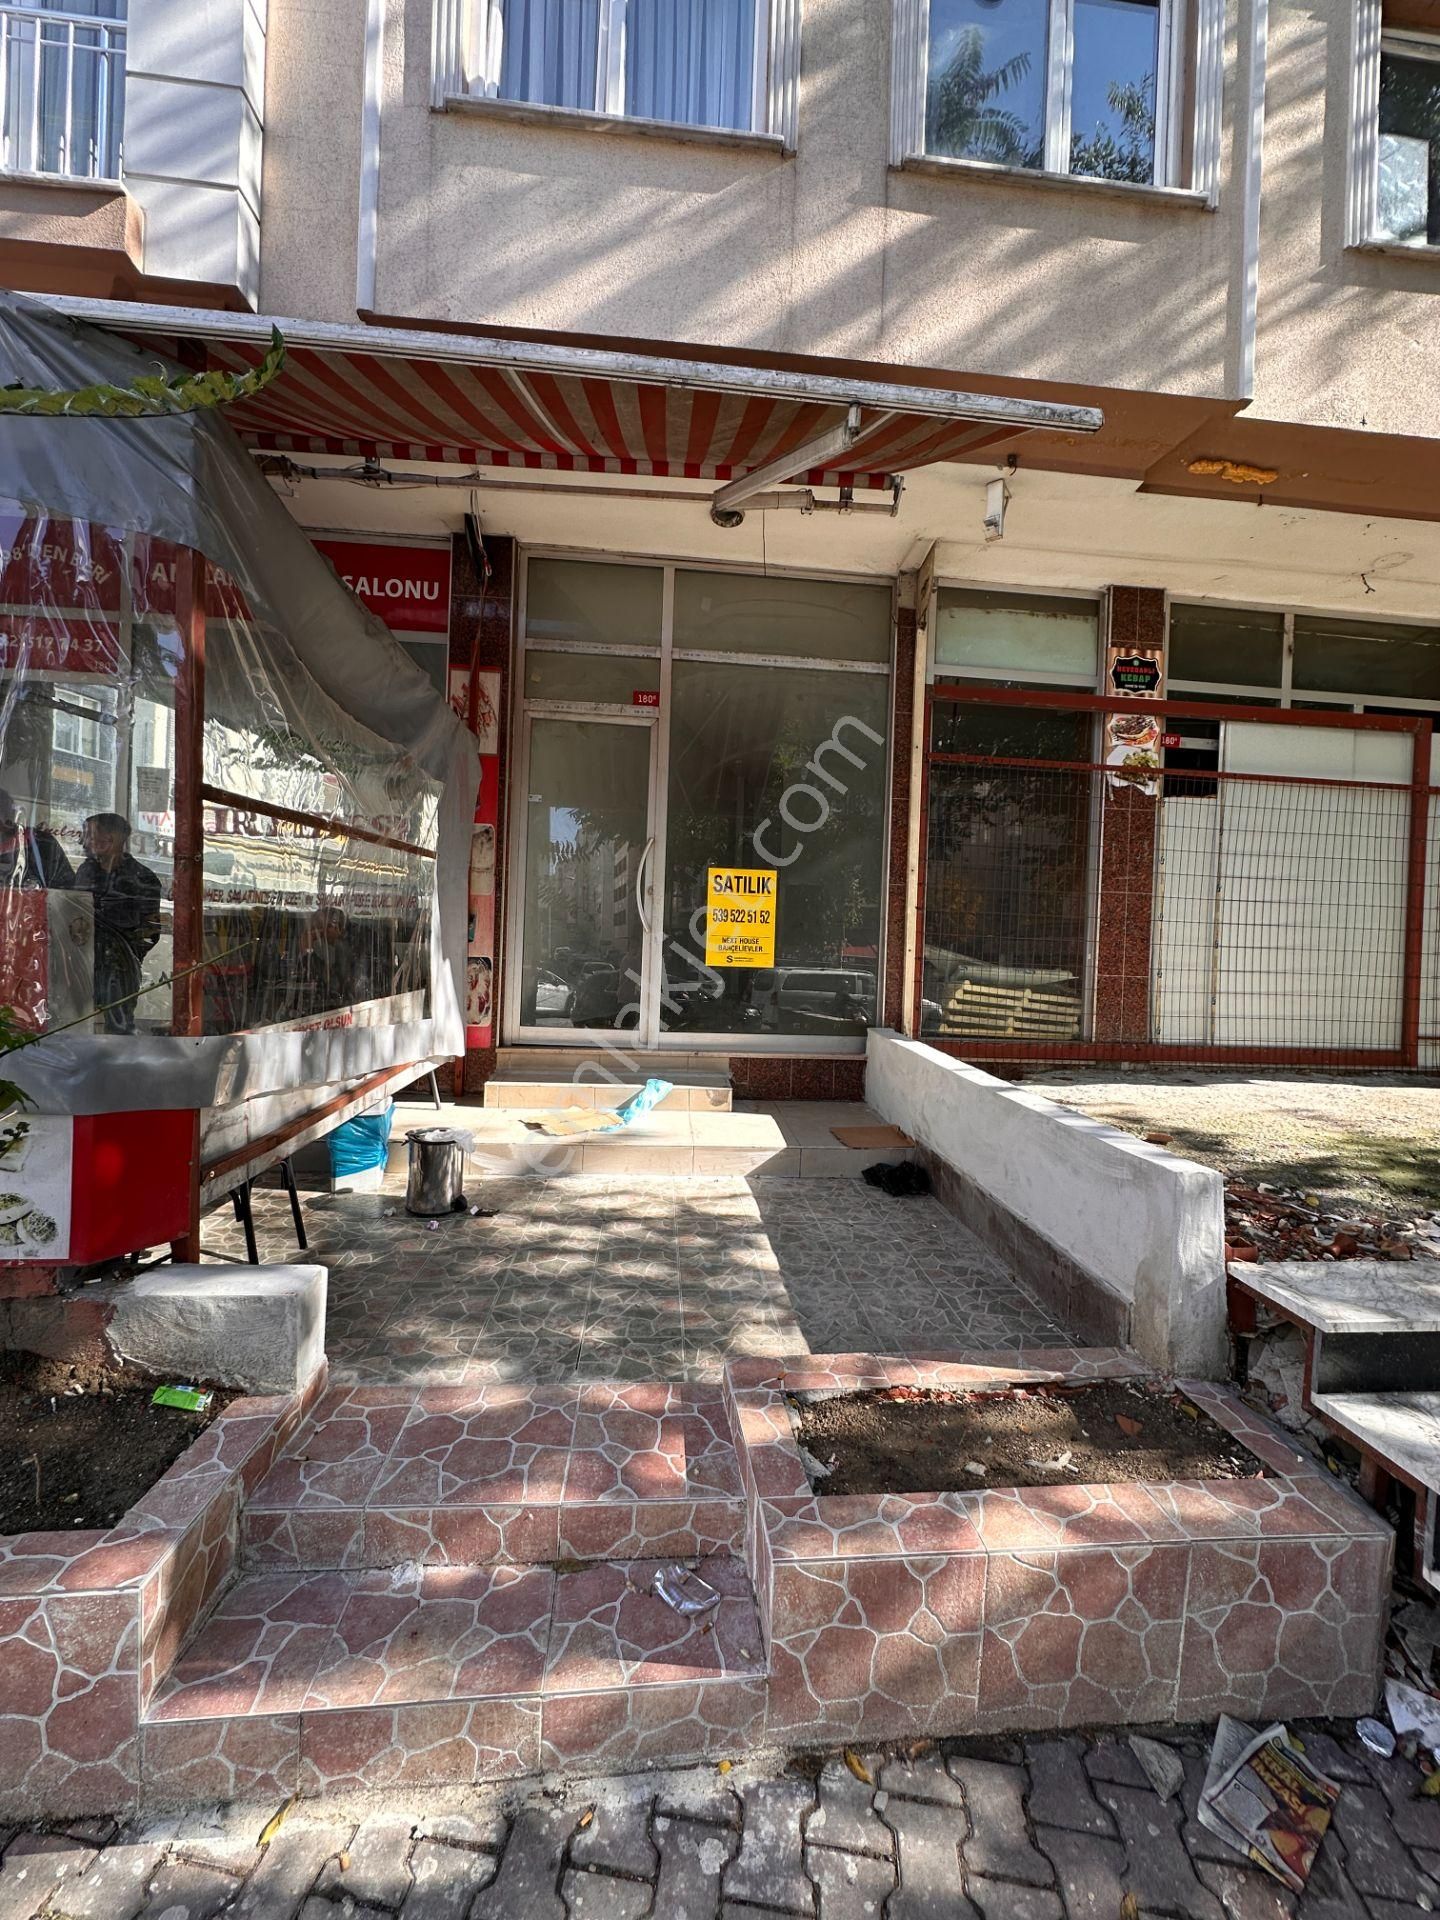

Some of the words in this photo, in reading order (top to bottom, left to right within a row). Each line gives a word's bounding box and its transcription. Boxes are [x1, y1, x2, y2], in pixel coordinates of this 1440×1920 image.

[341, 575, 439, 600] SALONU
[713, 874, 772, 894] SATILIK
[713, 909, 729, 922] 539
[730, 909, 745, 923] 522
[747, 910, 757, 923] 51
[760, 911, 770, 924] 52
